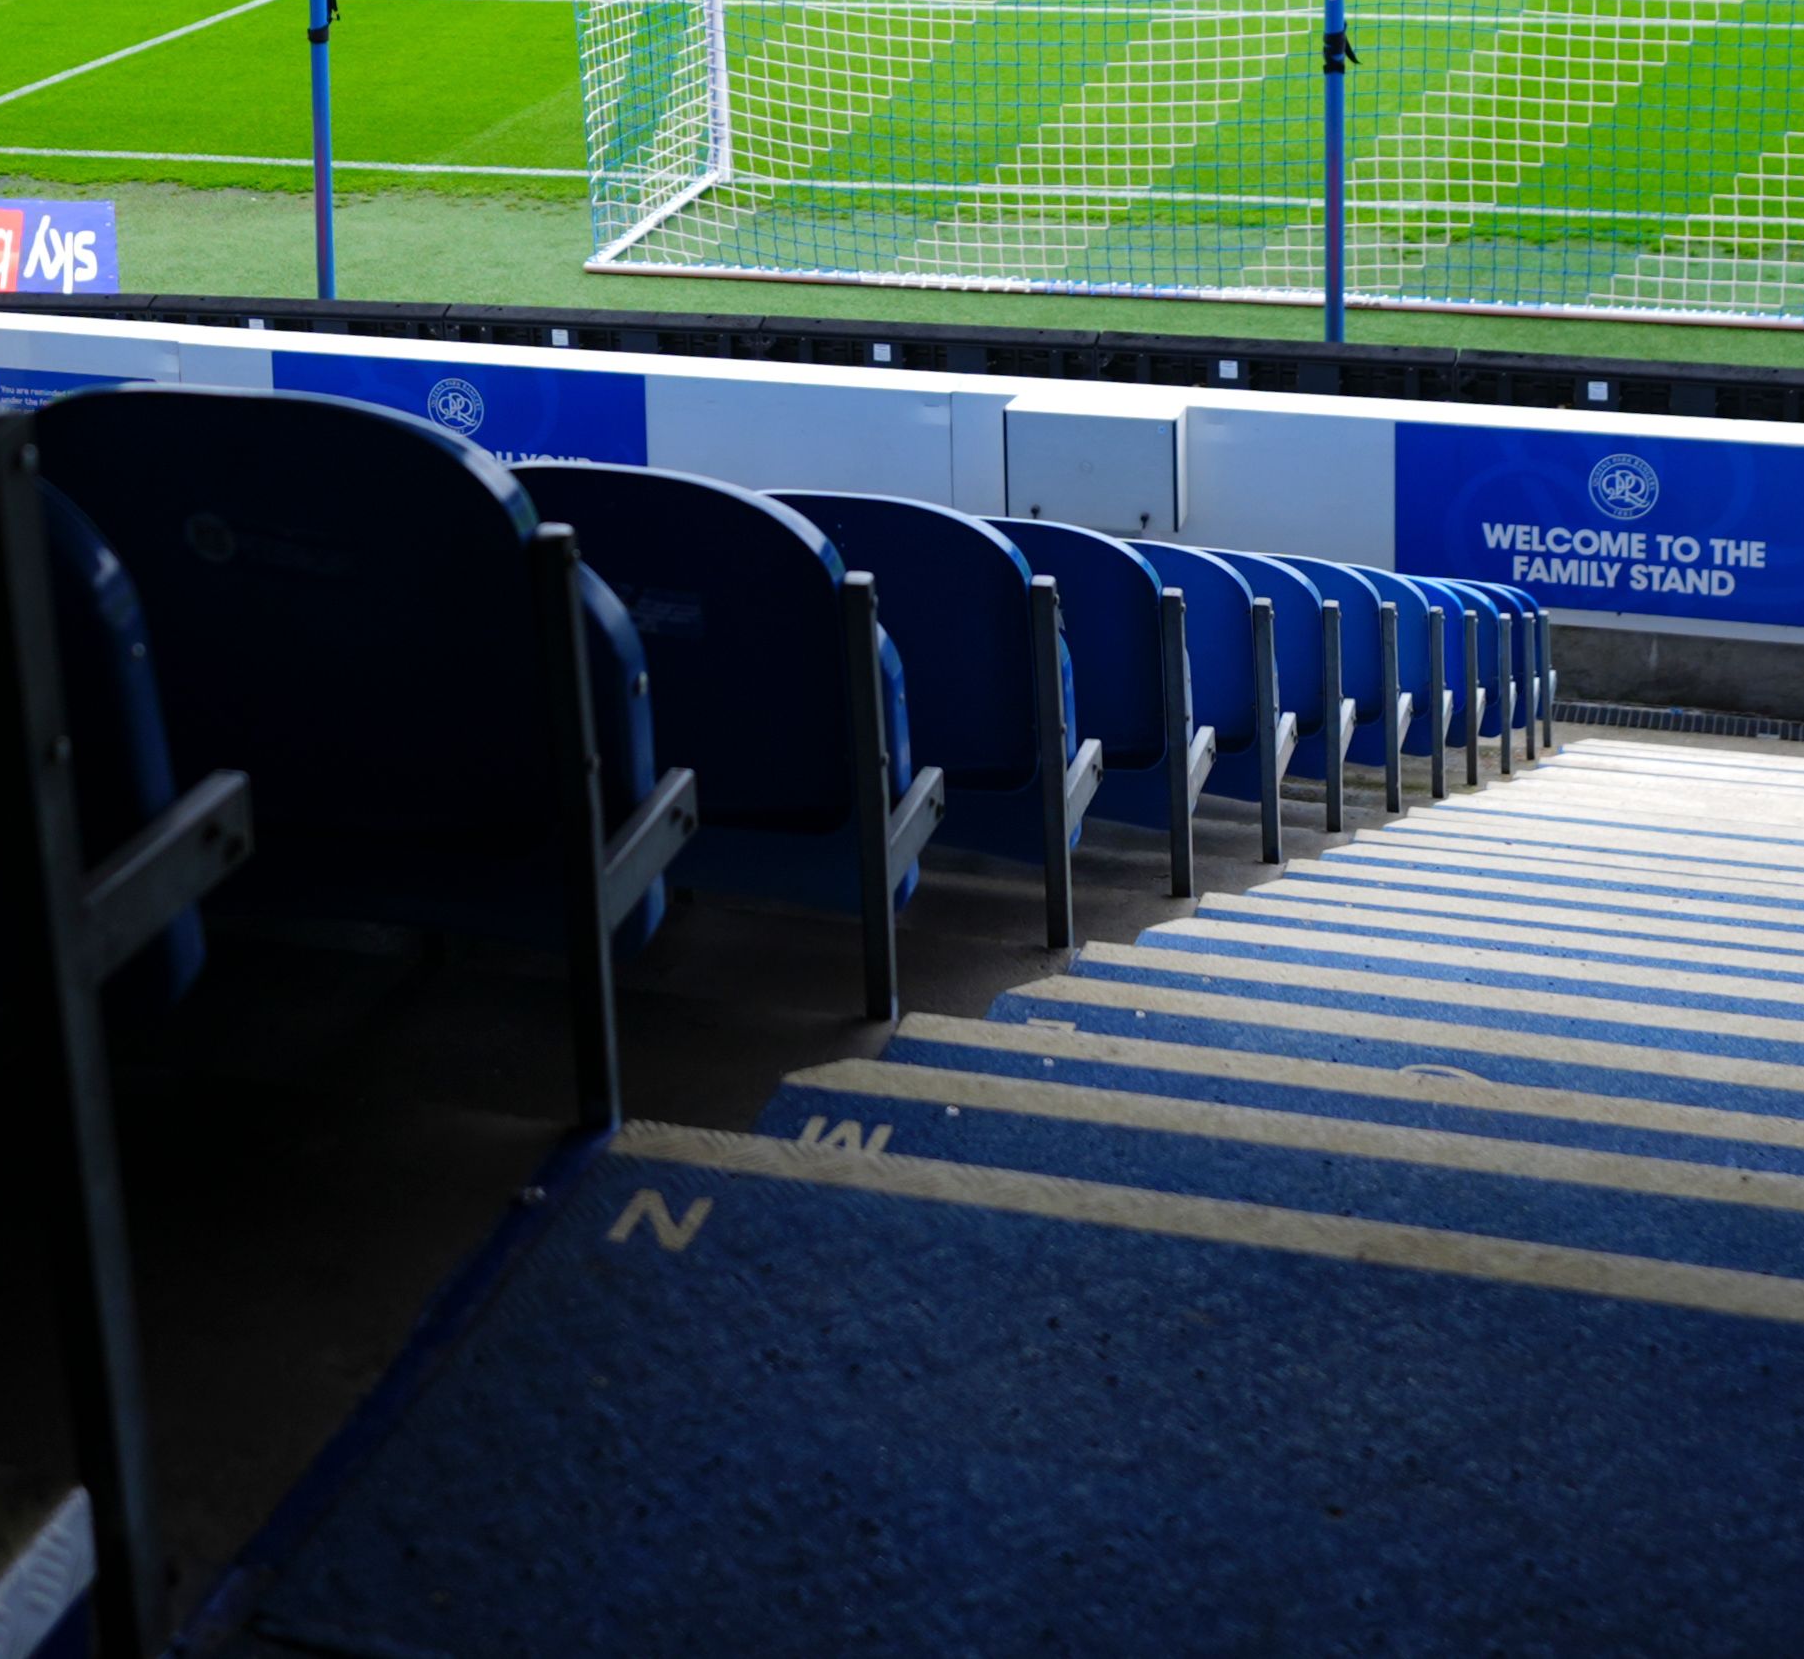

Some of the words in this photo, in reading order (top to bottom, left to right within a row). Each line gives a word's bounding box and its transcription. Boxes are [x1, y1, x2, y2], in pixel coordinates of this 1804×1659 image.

[24, 215, 97, 294] sky
[1482, 521, 1647, 560] WELCOME
[1656, 533, 1701, 564] TO
[1708, 537, 1767, 569] THE
[1512, 554, 1623, 588] FAMILY
[1629, 563, 1736, 597] STAND
